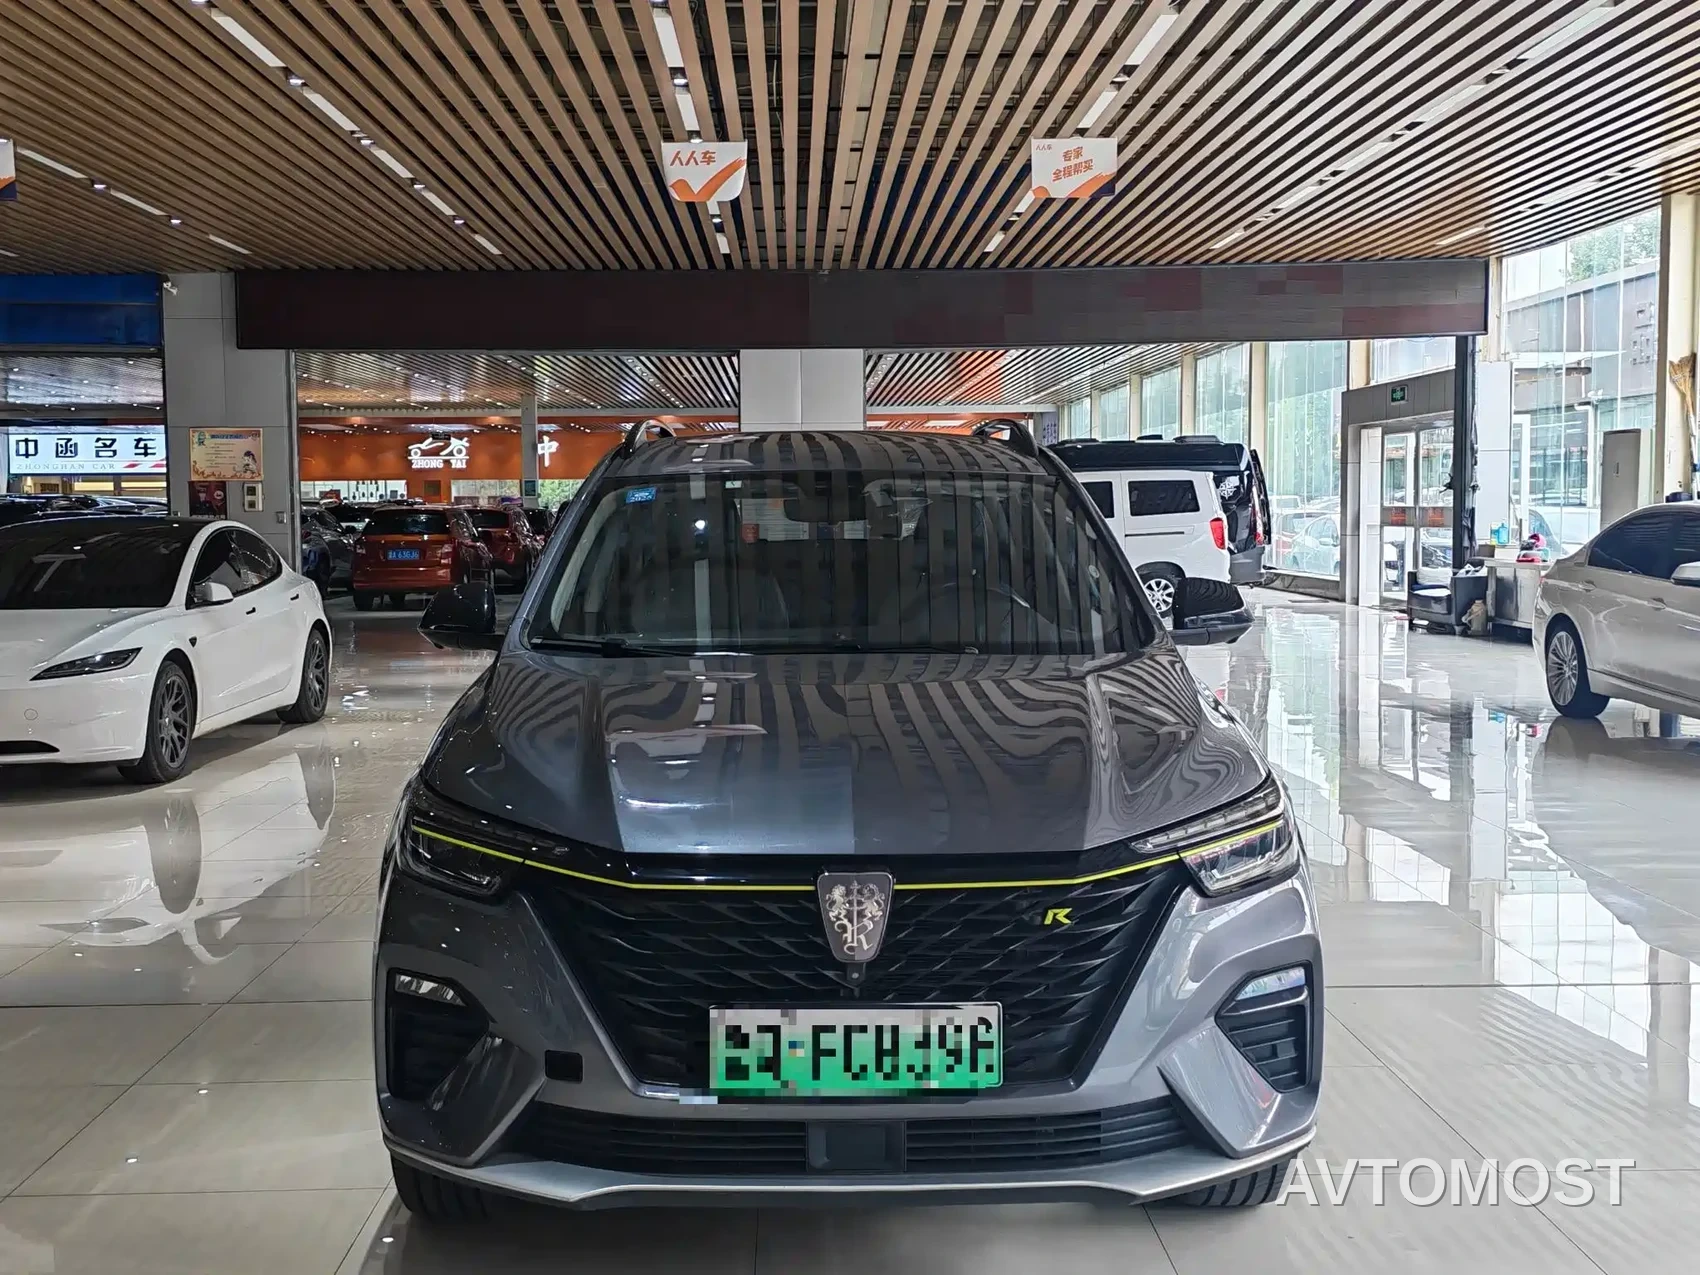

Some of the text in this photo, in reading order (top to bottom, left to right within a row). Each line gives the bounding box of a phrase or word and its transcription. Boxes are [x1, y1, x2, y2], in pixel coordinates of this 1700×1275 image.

[669, 150, 717, 167] 人人车
[1062, 146, 1084, 162] 专家
[1052, 158, 1094, 183] 全程帮买
[15, 437, 157, 459] 中函名车
[537, 435, 560, 468] 中
[411, 459, 467, 469] ZHONG TAI
[1043, 907, 1073, 925] R
